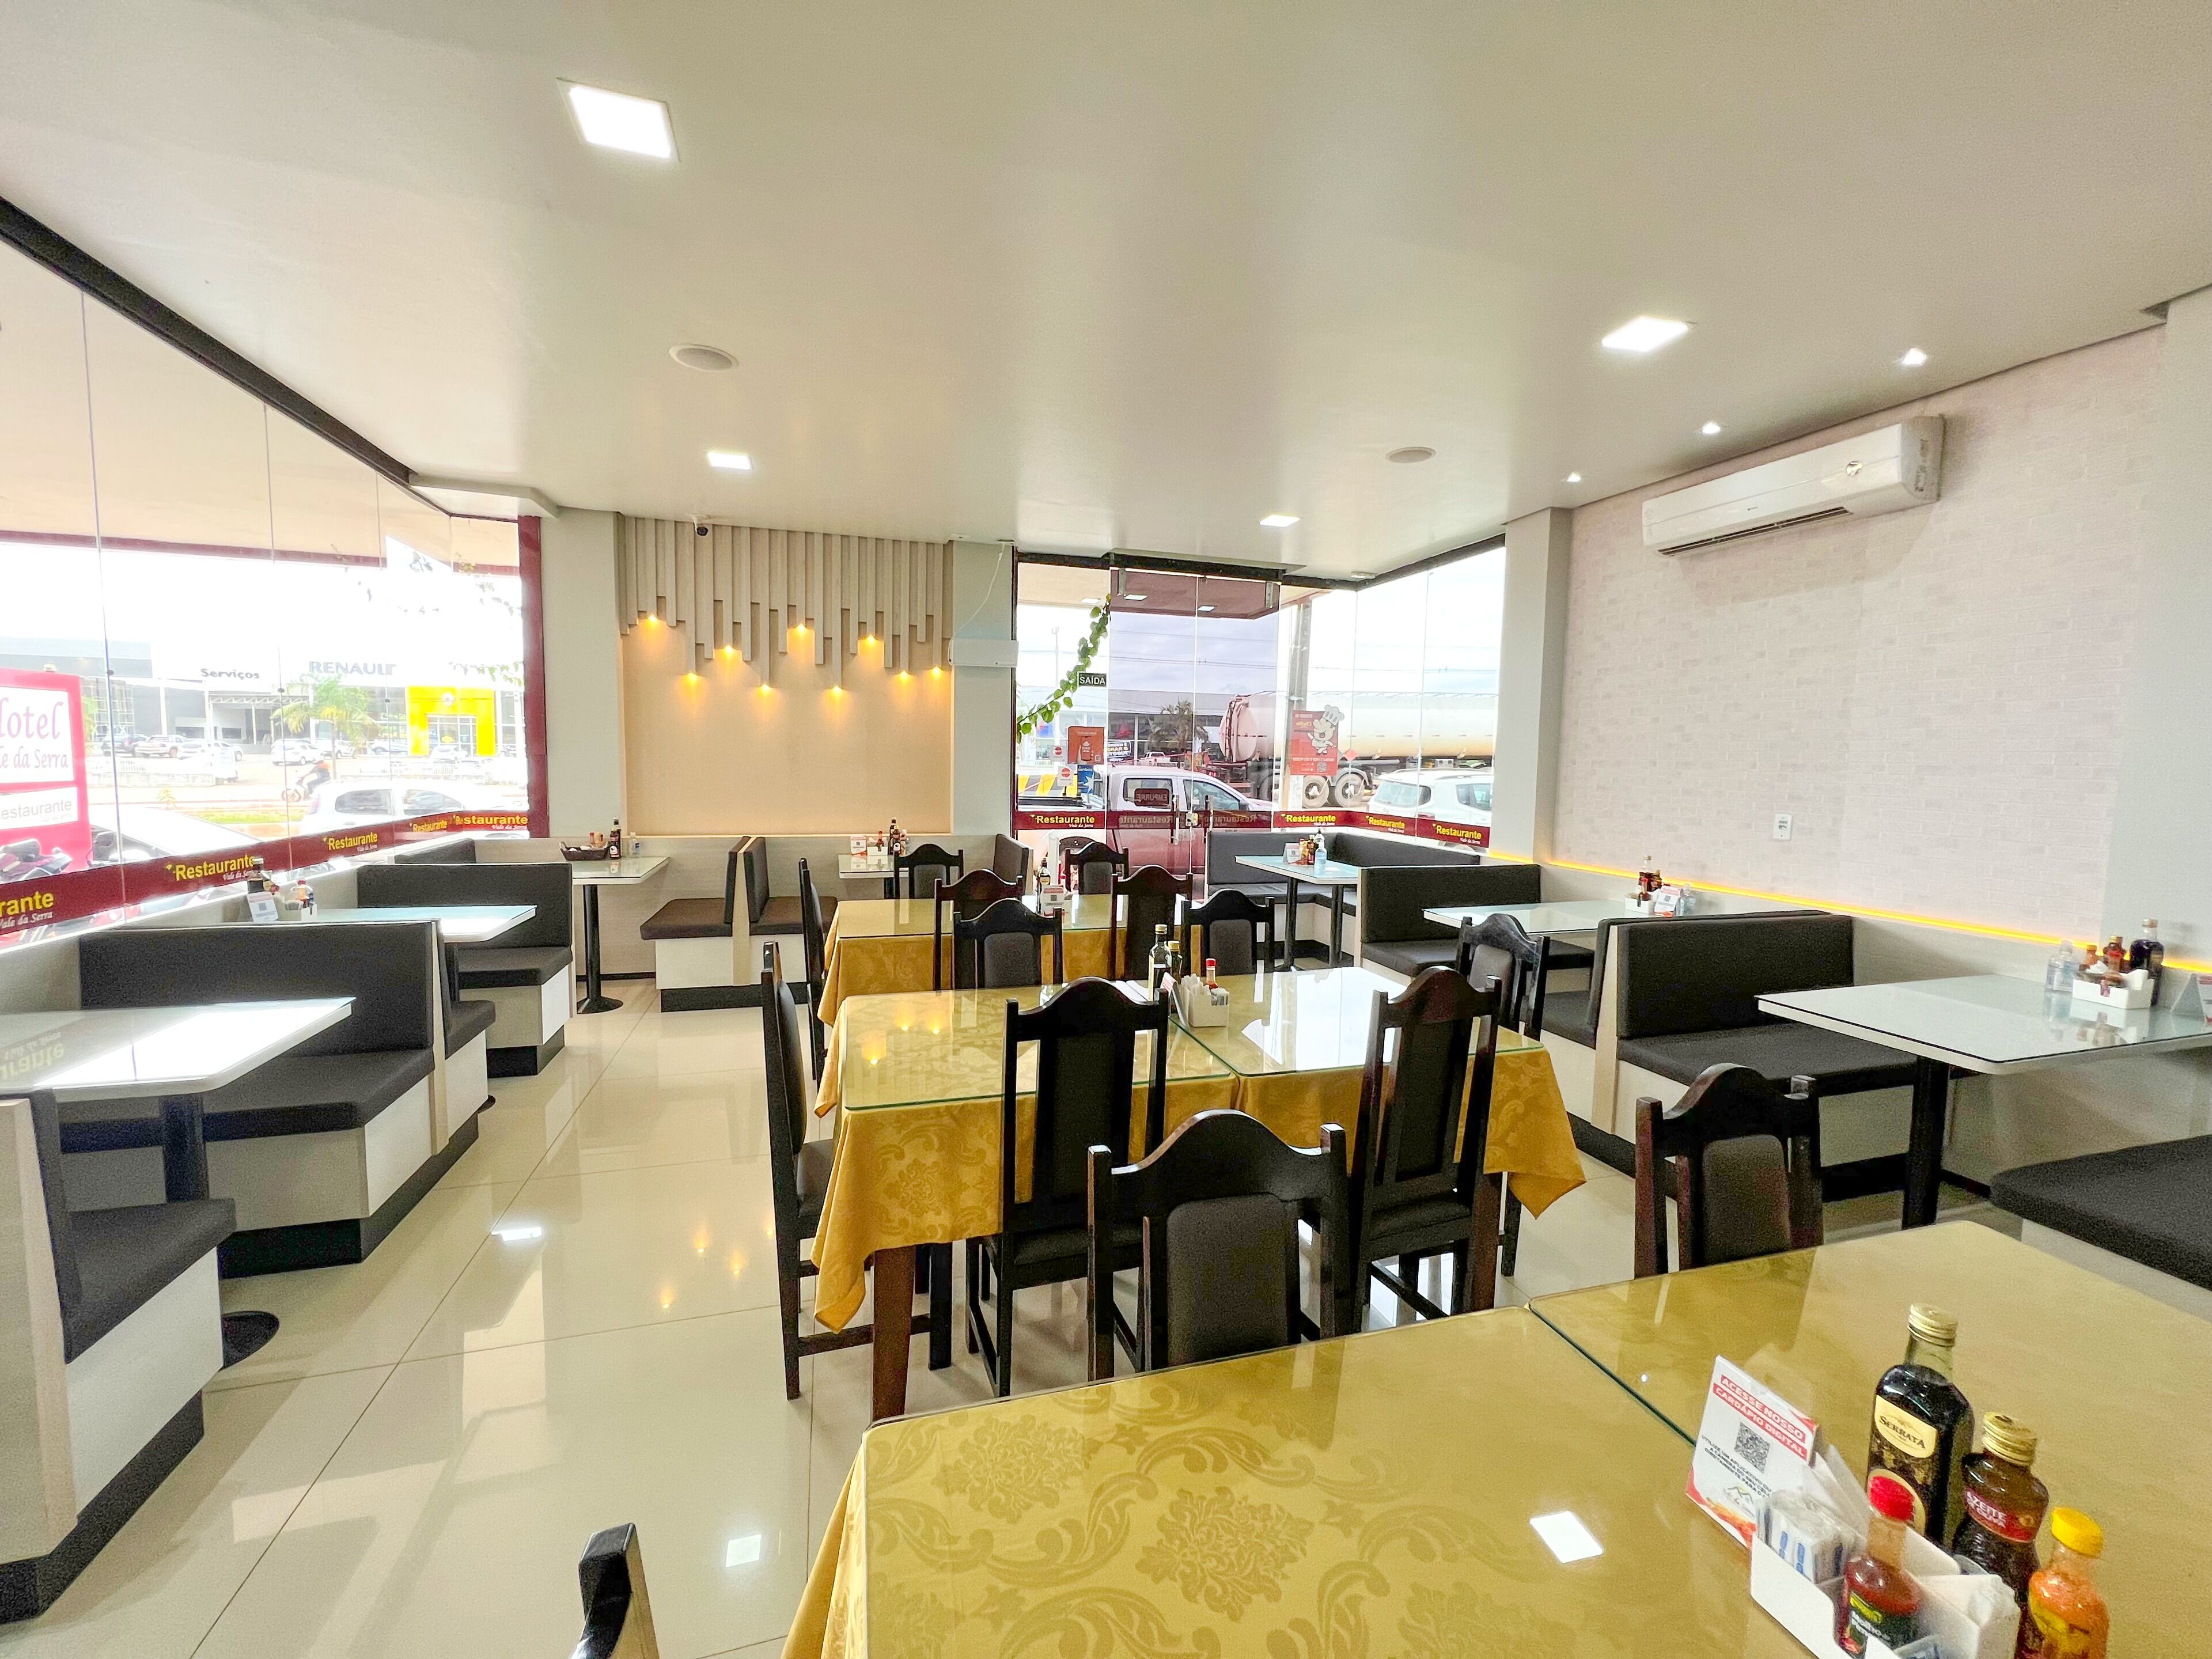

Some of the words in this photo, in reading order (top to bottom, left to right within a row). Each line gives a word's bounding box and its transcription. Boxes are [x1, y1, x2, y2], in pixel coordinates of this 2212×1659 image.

[200, 668, 260, 680] Serviços
[308, 661, 397, 675] RENAULT
[1079, 676, 1105, 685] SAÍDA
[13, 745, 31, 768] da
[35, 749, 69, 768] Serra
[1037, 815, 1095, 824] Restaurante
[1286, 814, 1336, 823] Restaurante
[1369, 816, 1405, 829] Restaurante
[413, 820, 447, 832] Restaurante
[1436, 825, 1482, 839] Restaurante
[328, 831, 378, 851] Restaurante
[175, 854, 255, 881] Restaurante
[1722, 1378, 1764, 1411] ACESSE
[1764, 1408, 1803, 1440] NOSSO
[1716, 1387, 1764, 1426] CARDÁPIO
[1765, 1423, 1805, 1457] DIGITAL
